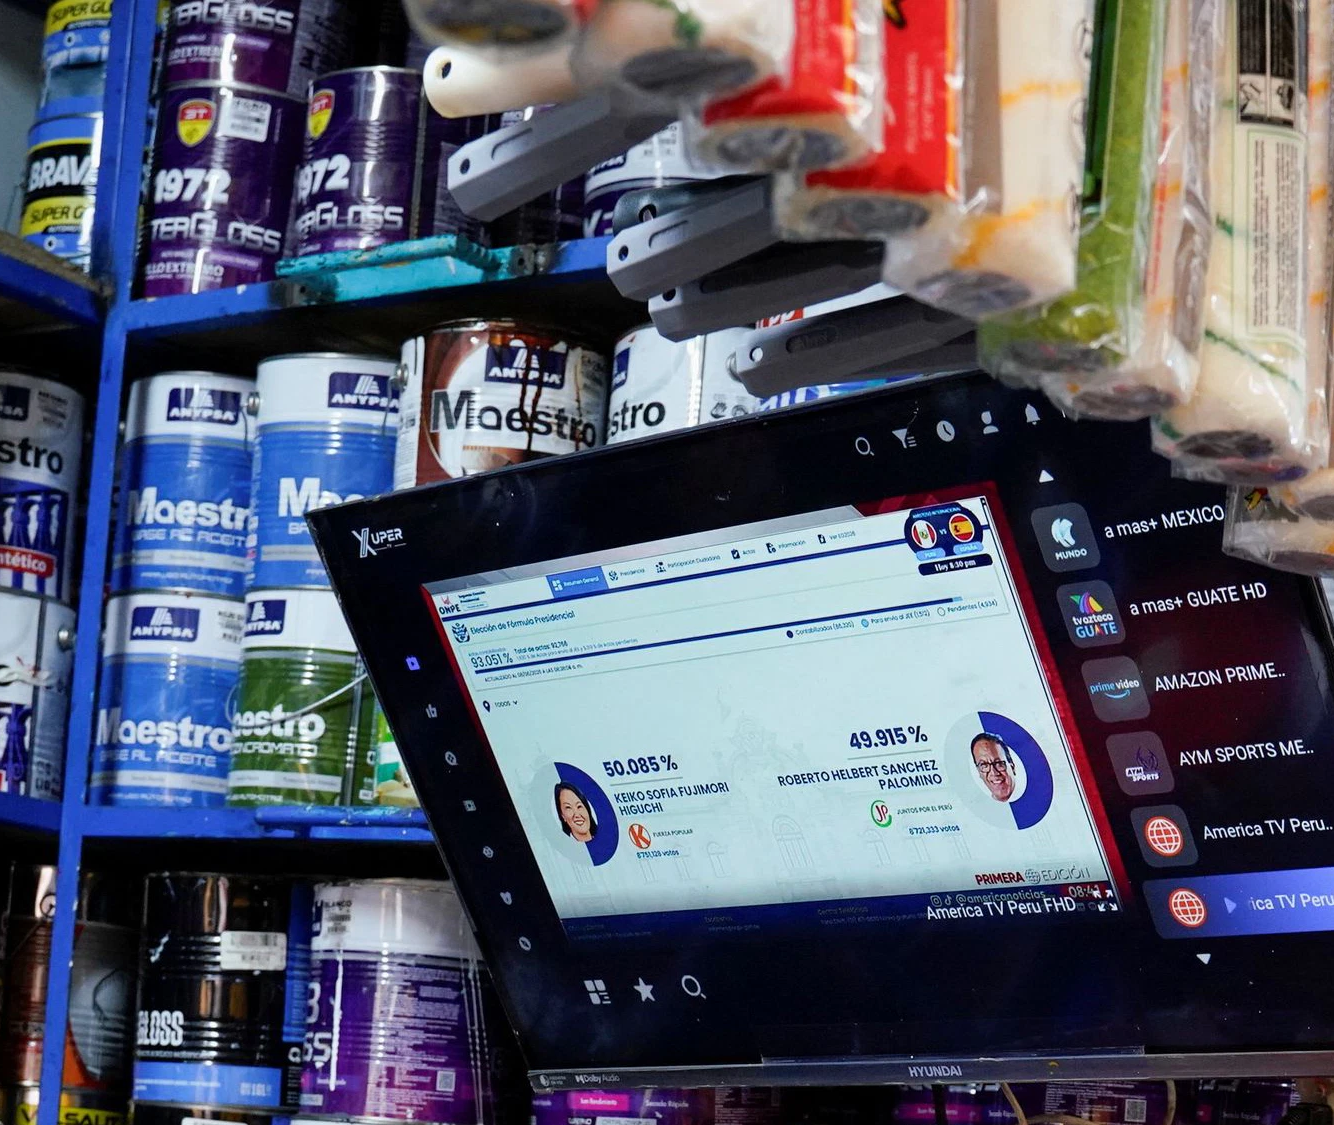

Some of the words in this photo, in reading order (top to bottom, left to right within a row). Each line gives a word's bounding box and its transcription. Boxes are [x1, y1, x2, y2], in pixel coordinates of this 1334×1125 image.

[154, 168, 232, 204] 1972
[430, 390, 598, 447] Maestro
[1104, 526, 1115, 539] a
[1117, 518, 1158, 537] mas+
[1160, 504, 1226, 530] MEXICO
[1055, 547, 1088, 561] MUNDO
[439, 602, 462, 616] ONPE
[1129, 603, 1140, 616] a
[1142, 596, 1184, 615] mas+
[1186, 585, 1240, 608] GUATE
[1241, 581, 1267, 600] HD
[470, 622, 498, 635] Elección
[498, 620, 507, 631] de
[506, 614, 534, 629] Fórmula
[534, 610, 576, 624] Presidencial
[1076, 622, 1118, 639] GUATE
[1090, 682, 1116, 695] prime
[1115, 678, 1140, 691] video
[1155, 669, 1222, 692] AMAZON
[96, 707, 232, 753] Maestro
[1179, 749, 1213, 767] AYM
[1214, 742, 1277, 764] SPORTS
[777, 770, 831, 787] ROBERTO
[830, 764, 880, 781] HELBERT
[880, 759, 939, 776] SANCHEZ
[878, 773, 943, 791] PALOMINO
[614, 790, 646, 804] KEIKO
[646, 787, 678, 801] SOFIA
[678, 782, 730, 797] FUJIMORI
[618, 802, 664, 817] HIGUCHI
[1202, 822, 1264, 840] America
[1264, 819, 1286, 834] TV
[974, 871, 1026, 886] PRIMERA
[1042, 865, 1091, 882] EDICIÓN
[927, 902, 985, 921] America
[983, 901, 1007, 916] TV
[1008, 898, 1042, 915] Peru
[1042, 896, 1077, 913] FHD
[1274, 894, 1297, 908] TV
[907, 1064, 962, 1079] HYUNDAI
